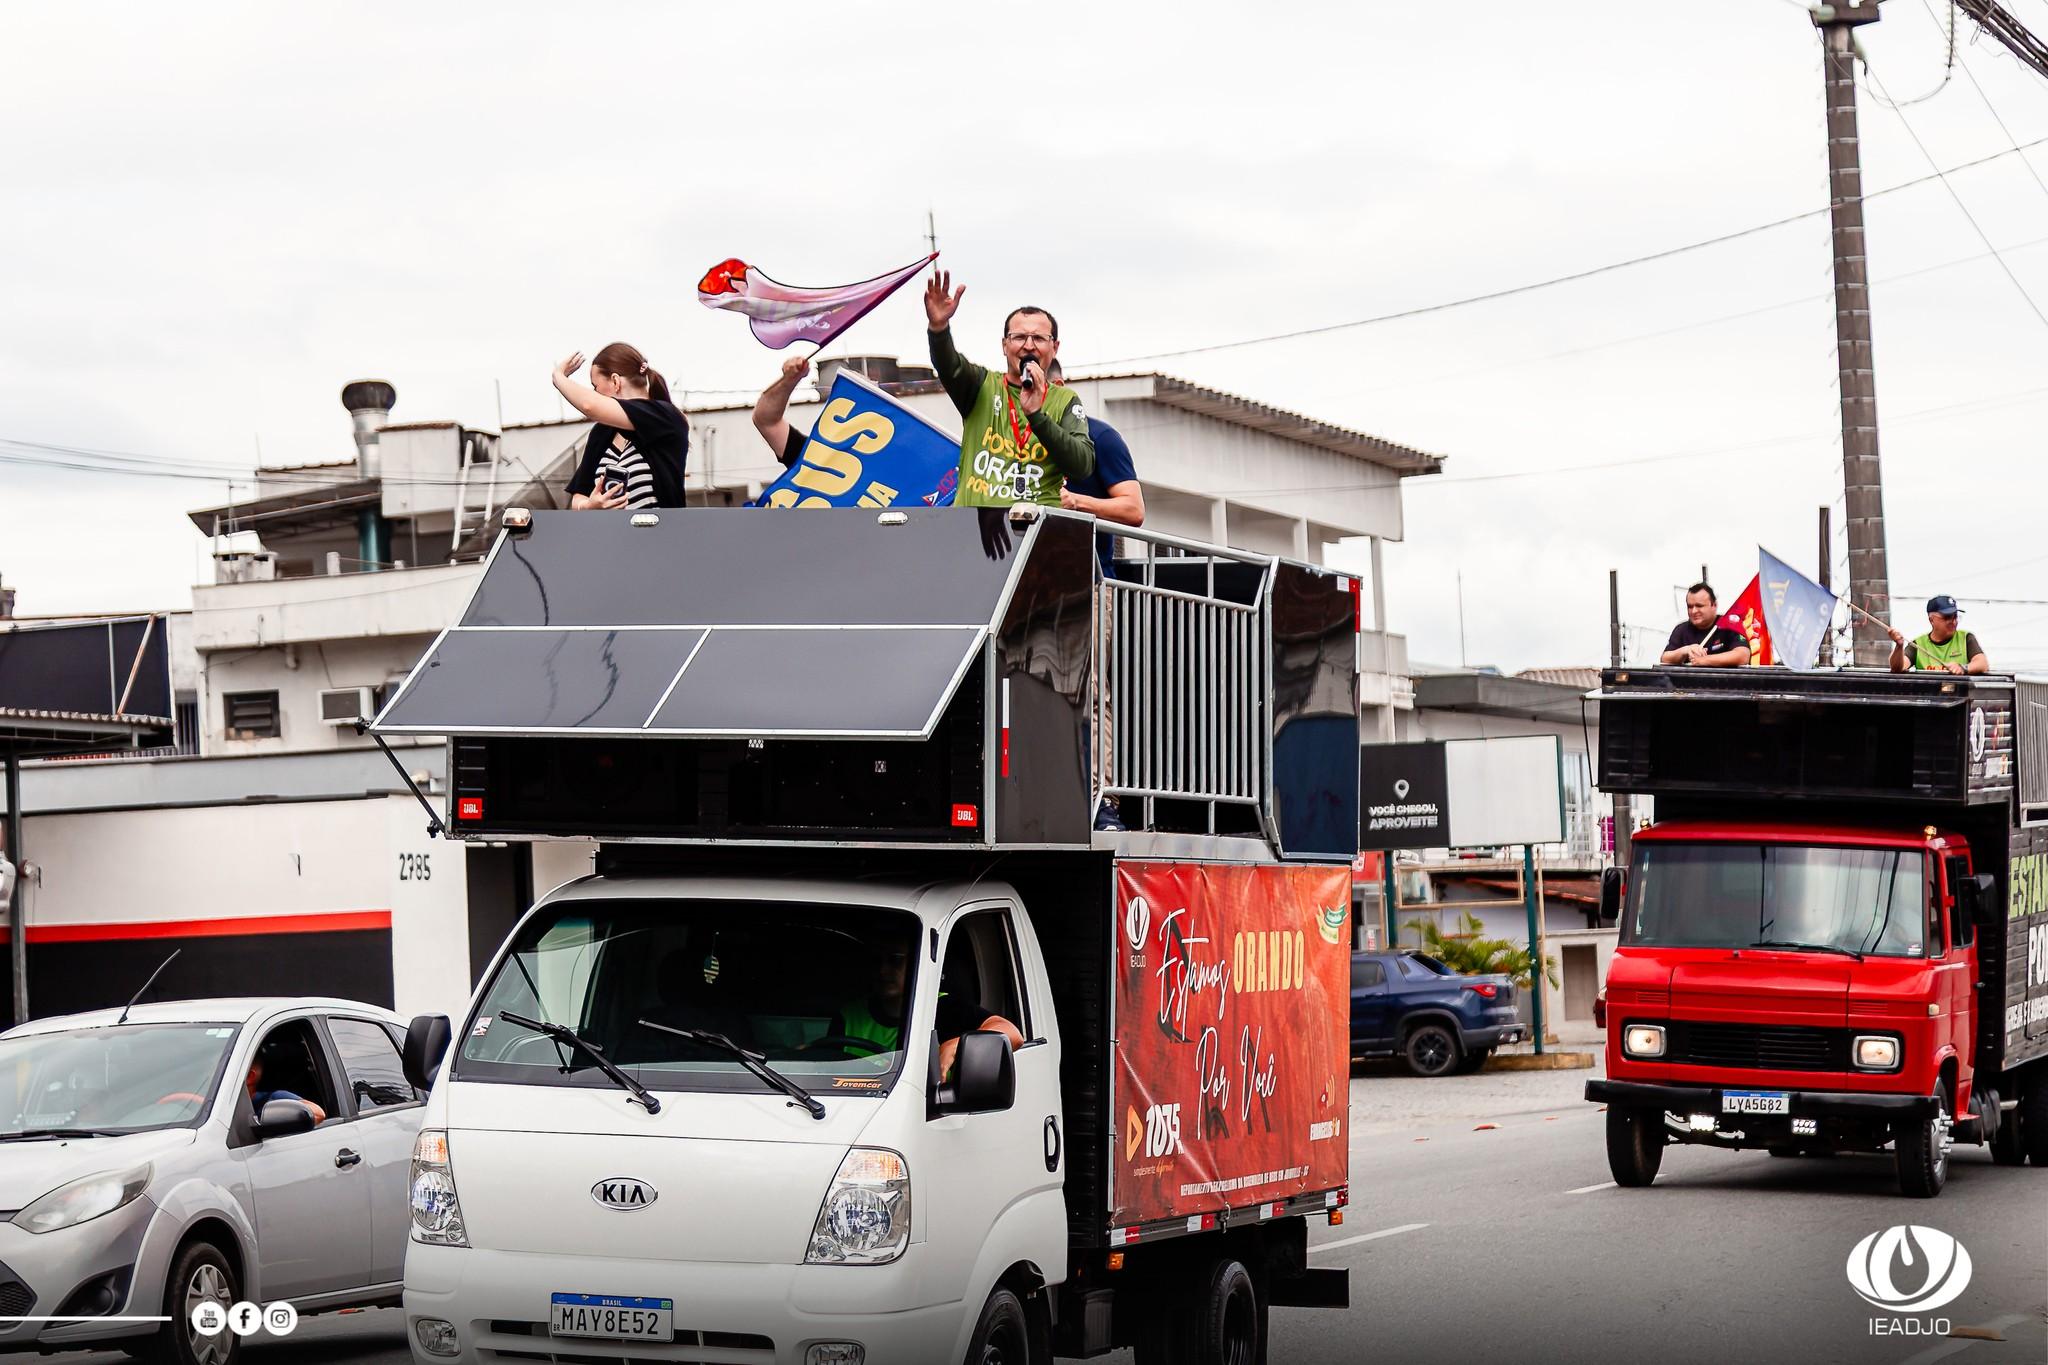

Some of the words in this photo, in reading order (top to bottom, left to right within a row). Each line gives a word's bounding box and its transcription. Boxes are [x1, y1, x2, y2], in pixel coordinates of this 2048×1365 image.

[973, 450, 1044, 488] ORAR
[966, 475, 989, 496] POR
[957, 809, 974, 821] JBL
[1369, 803, 1396, 816] VOCÊ
[1396, 803, 1438, 815] CHEGOU,
[399, 853, 431, 881] 2785
[1156, 908, 1230, 1041] Estamos
[1233, 930, 1305, 994] ORANDO
[1196, 1026, 1230, 1140] Por
[1240, 1025, 1277, 1122] Você
[1729, 1098, 1782, 1111] LYA5G82
[602, 1183, 646, 1204] KIA
[562, 1307, 659, 1335] MAY8E52
